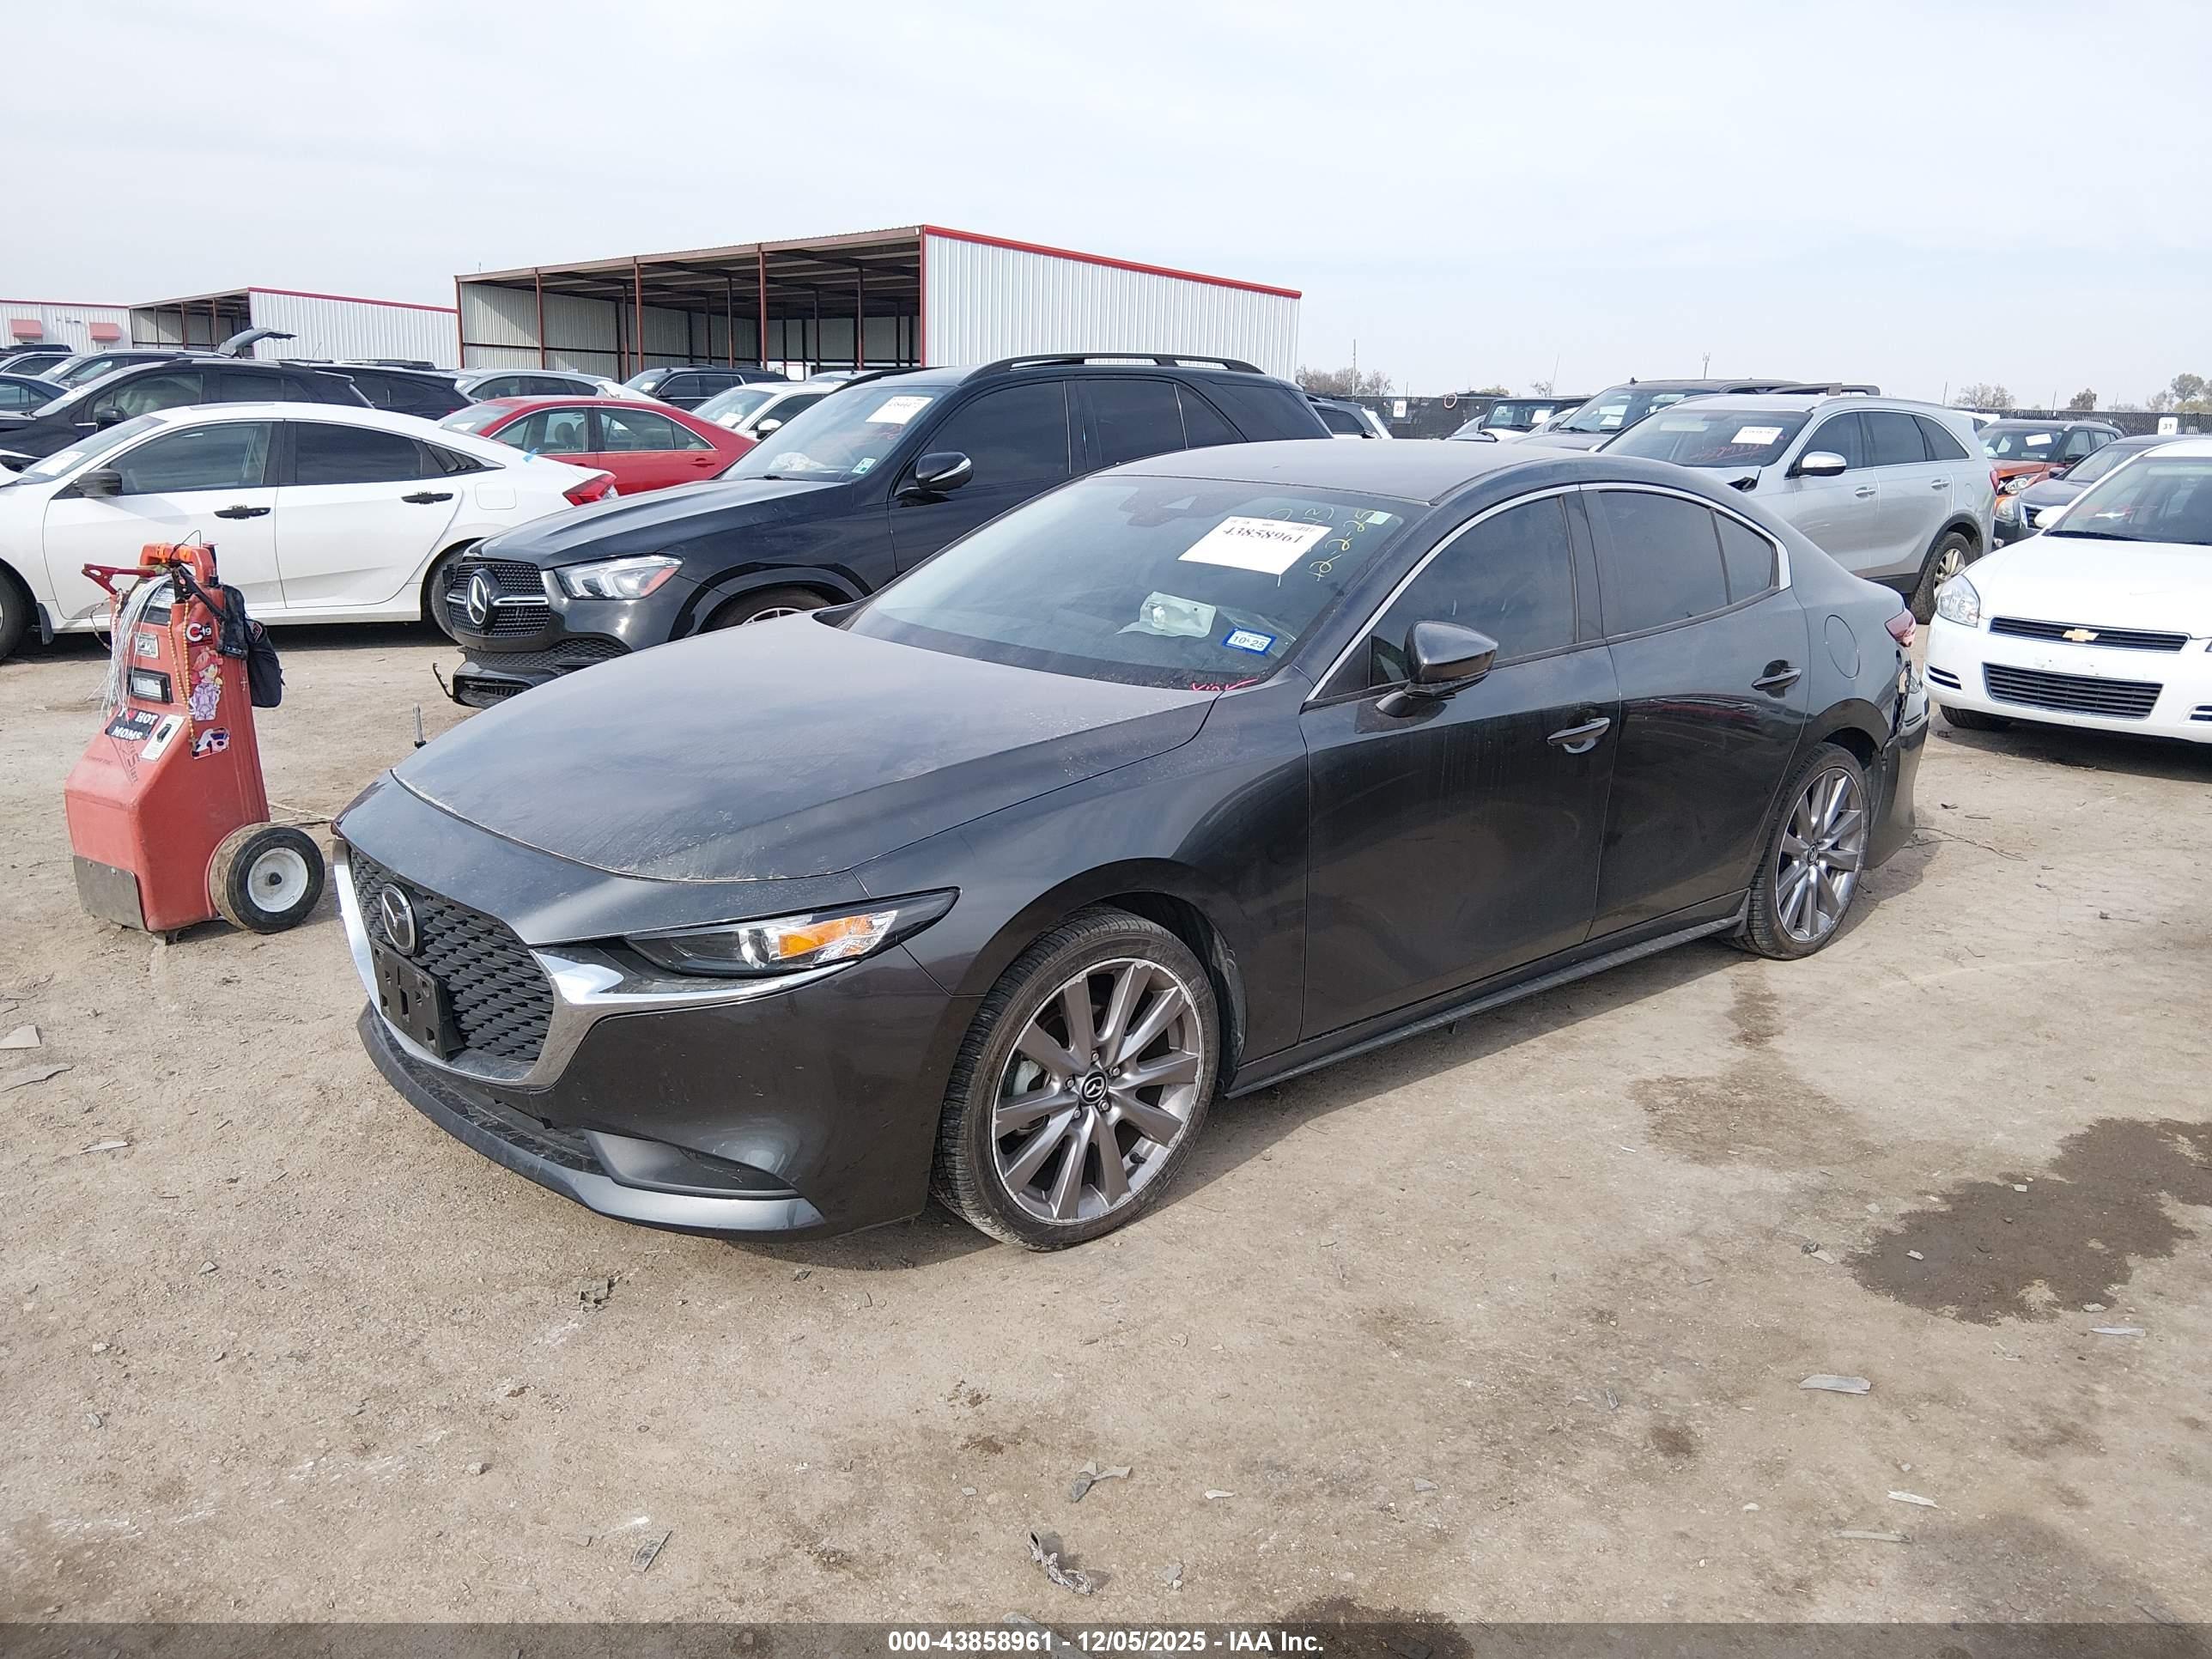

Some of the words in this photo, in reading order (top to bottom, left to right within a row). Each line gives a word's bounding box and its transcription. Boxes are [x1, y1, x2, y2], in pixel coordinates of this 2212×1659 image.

[1222, 526, 1305, 544] 43858961
[134, 711, 159, 726] HOT
[111, 726, 143, 740] MOMS
